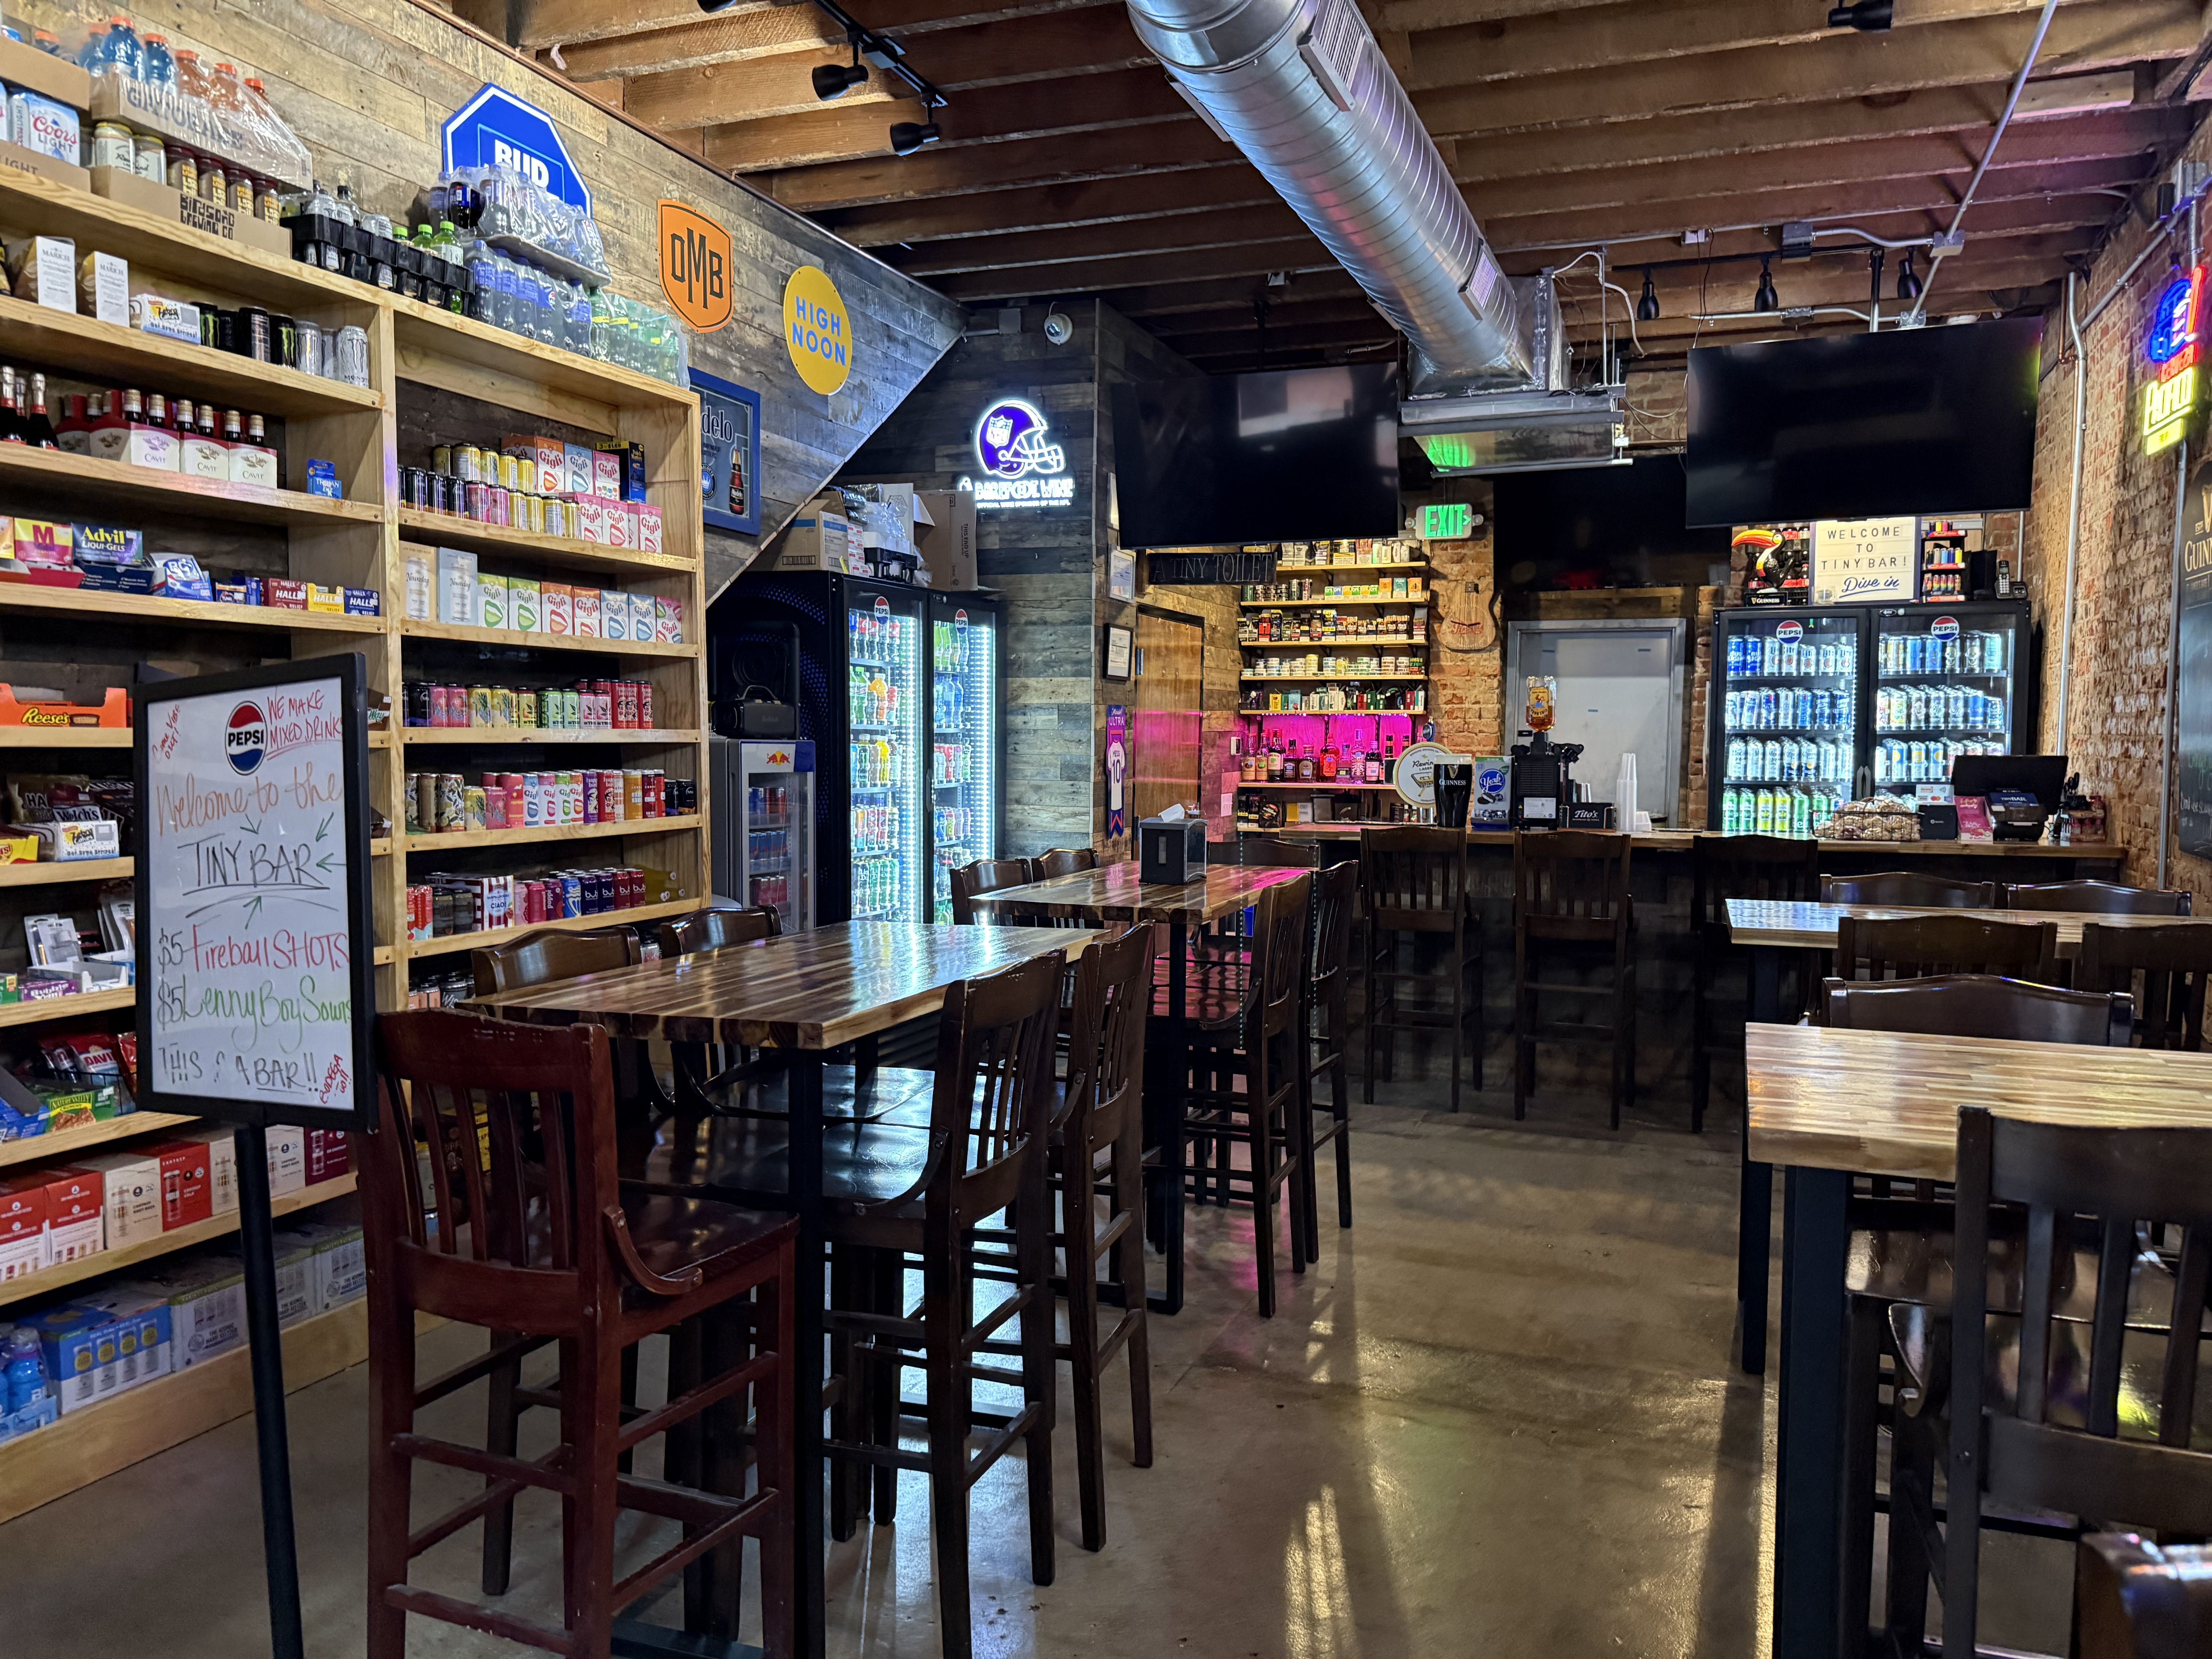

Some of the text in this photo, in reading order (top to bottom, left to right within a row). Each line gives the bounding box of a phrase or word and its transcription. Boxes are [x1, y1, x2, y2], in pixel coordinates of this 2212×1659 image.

[31, 114, 77, 144] Coors
[38, 133, 74, 153] LIGHT
[42, 249, 70, 262] MARICH
[100, 263, 124, 276] MARICH
[671, 227, 724, 309] OMB
[795, 295, 841, 338] HIGH
[792, 321, 847, 366] NOON
[539, 451, 563, 469] Gigli
[570, 456, 588, 471] Gigli
[598, 462, 617, 478] Gigli
[580, 505, 601, 523] Gigli
[607, 510, 624, 525] Gigli
[1425, 505, 1466, 537] EXIT
[641, 517, 660, 534] Gigli
[1828, 526, 1900, 540] WELCOME
[82, 526, 125, 544] Advil
[963, 550, 969, 558] UP
[1856, 543, 1874, 553] TO
[1153, 559, 1166, 582] A
[1170, 558, 1208, 579] TINY
[1212, 554, 1273, 582] TOILET
[1822, 556, 1906, 570] TINY BAR!
[484, 586, 501, 599] Gigli
[1842, 576, 1899, 592] Dive in
[517, 590, 534, 603] Gigli
[548, 595, 566, 609] Gigli
[577, 599, 599, 617] Gigli
[606, 602, 624, 616] Gigli
[635, 605, 651, 618] Gigli
[662, 621, 677, 634] Gigli
[268, 690, 325, 723] WE MAKE
[166, 704, 180, 730] VIBE
[1109, 717, 1125, 726] ULTRA
[165, 726, 181, 760] OUT!
[228, 729, 264, 747] PEPSI
[270, 722, 302, 749] MIXED
[1113, 759, 1121, 784] 10
[1480, 773, 1503, 793] York
[157, 762, 343, 837] Welcome to the
[57, 808, 99, 821] Welch's
[1574, 809, 1598, 818] Tito's
[177, 833, 323, 888] TINY BAR
[158, 915, 349, 974] $5 Fireball SHOTS
[31, 983, 69, 996] Bubble
[158, 978, 184, 1031] $5
[182, 973, 258, 1053] Lenny
[260, 981, 302, 1054] Boy
[158, 1042, 203, 1084] THIS
[236, 1055, 250, 1085] A
[254, 1052, 318, 1092] BAR!!
[319, 1054, 343, 1104] BODEGA
[51, 1094, 91, 1110] NATURE VALLEY
